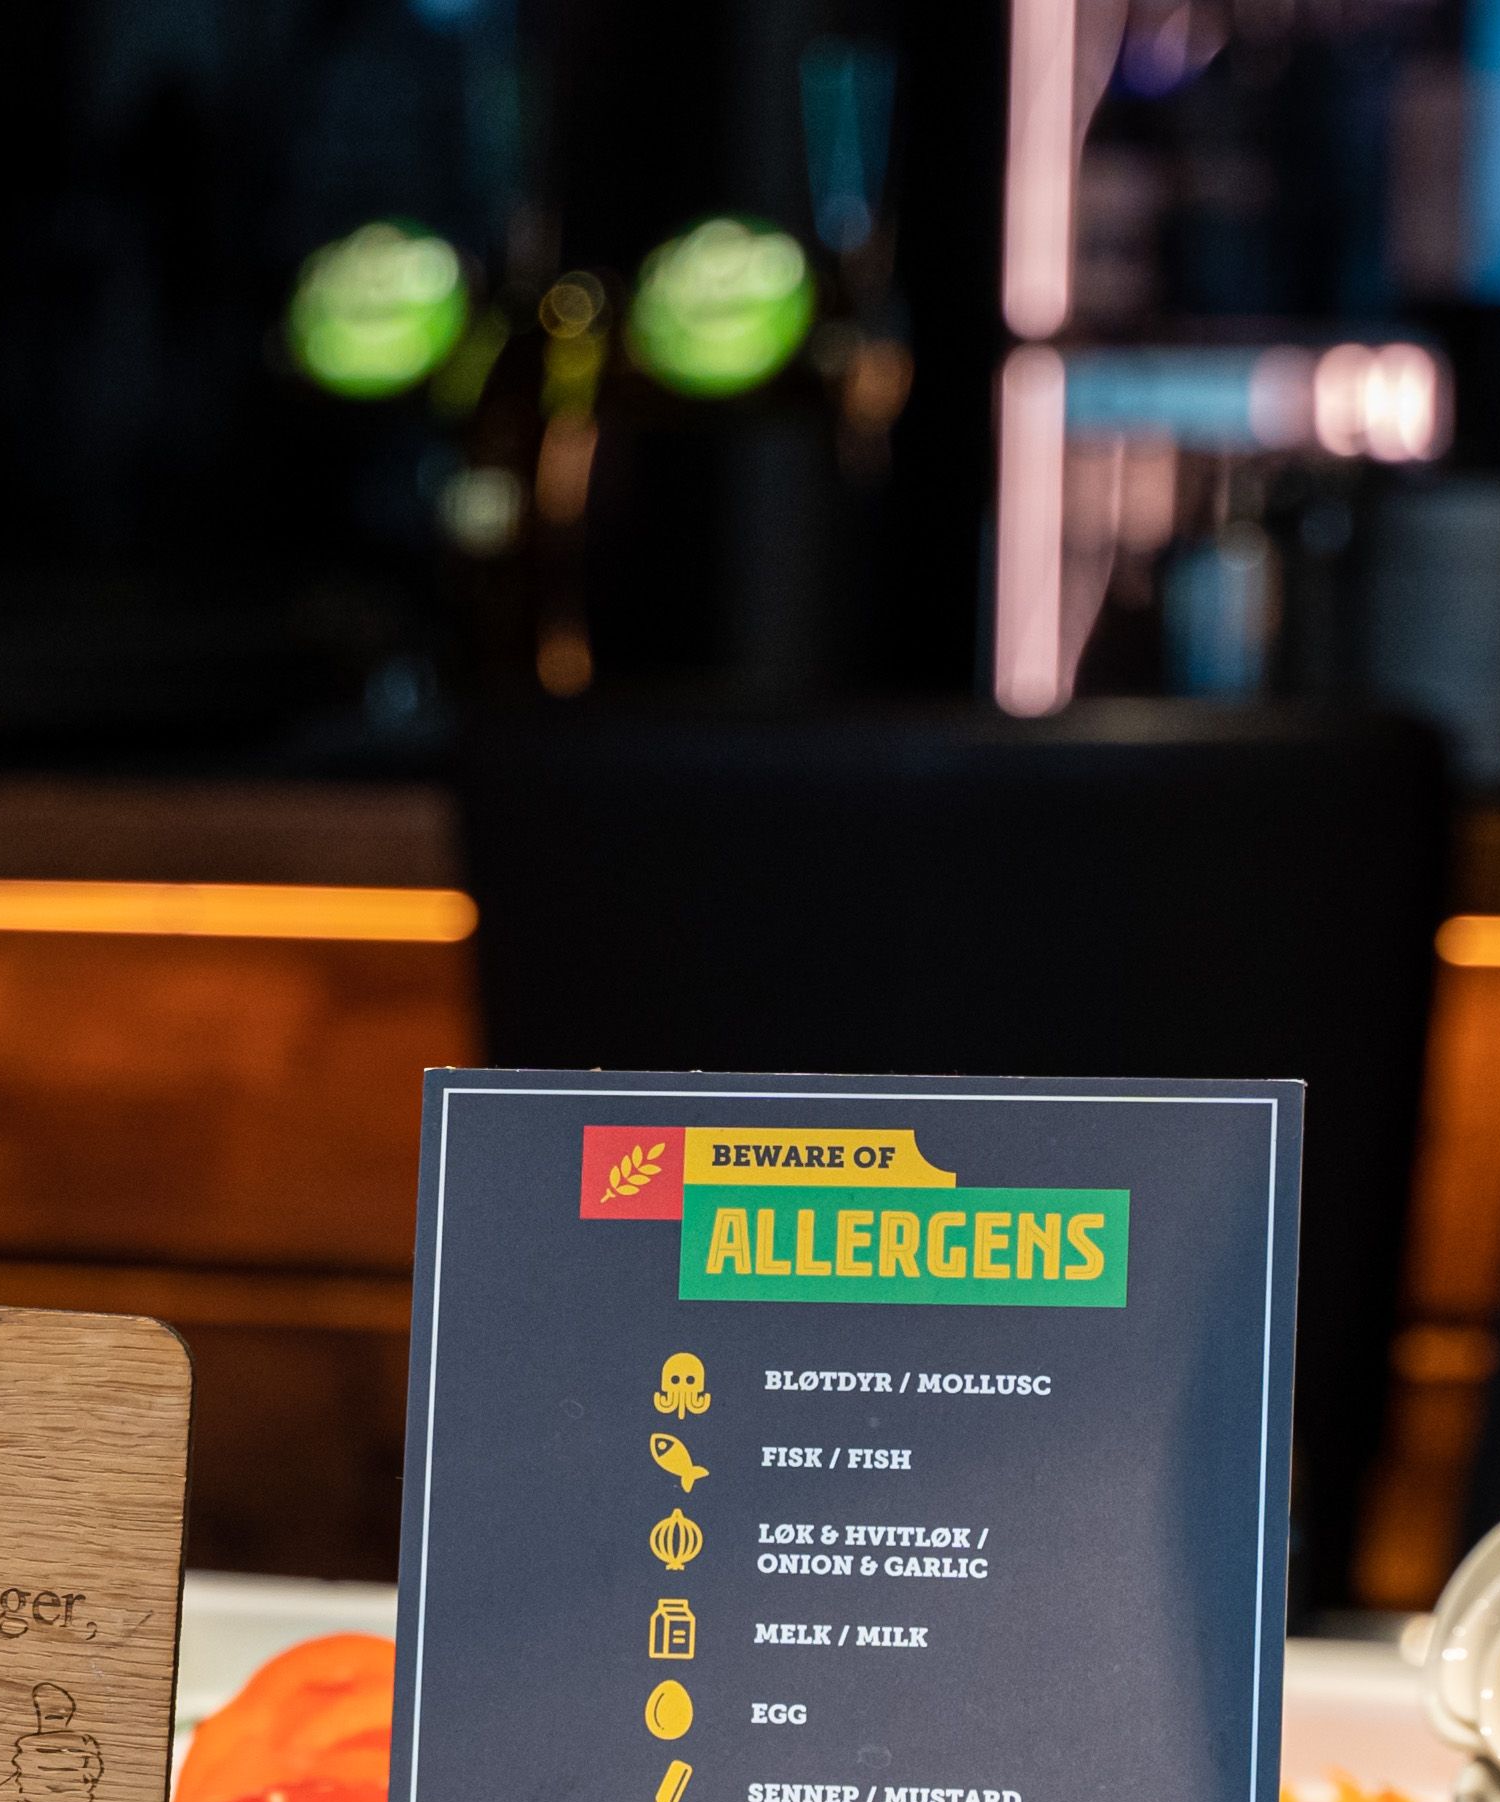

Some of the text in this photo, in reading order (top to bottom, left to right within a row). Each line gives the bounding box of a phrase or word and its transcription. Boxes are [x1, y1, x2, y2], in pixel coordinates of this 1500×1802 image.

[712, 1145, 895, 1168] BEWARE OF
[706, 1209, 1104, 1280] ALLERGENS
[765, 1371, 1051, 1395] BLØTDYR / MOLLUSC
[762, 1447, 911, 1469] FISK / FISH
[759, 1524, 989, 1549] LØK & HVITLØK /
[757, 1553, 988, 1578] ONION & GARLIC
[754, 1624, 928, 1647] MELK / MILK
[751, 1703, 807, 1724] EGG
